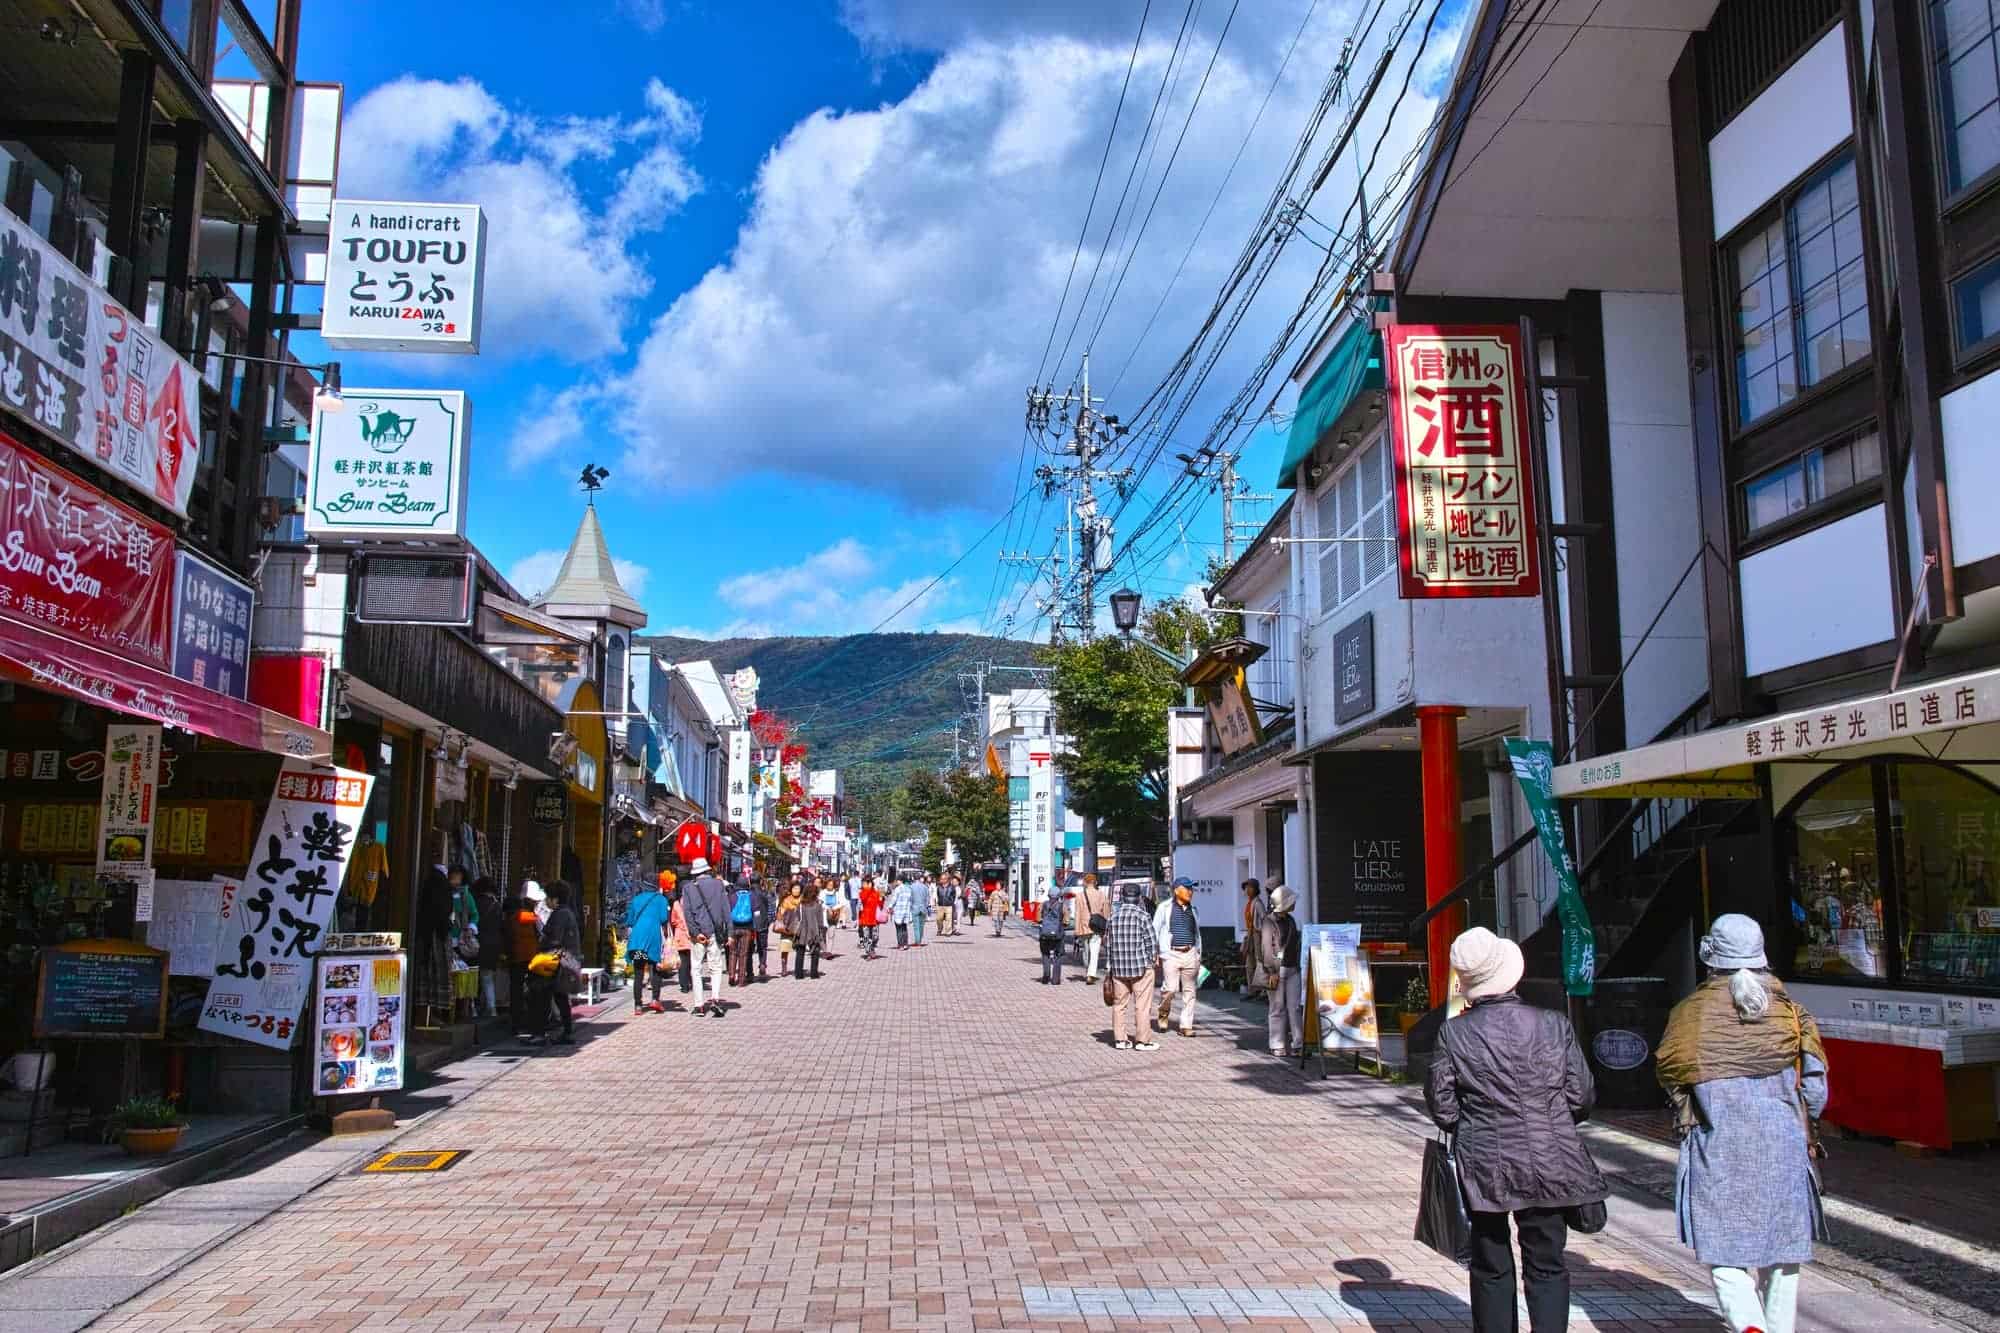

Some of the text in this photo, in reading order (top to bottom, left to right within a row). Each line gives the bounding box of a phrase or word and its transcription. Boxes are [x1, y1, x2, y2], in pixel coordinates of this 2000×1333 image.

[351, 213, 461, 232] A handicraft
[342, 237, 467, 265] TOUFU
[0, 229, 90, 369] 料理
[350, 271, 455, 304] とうふ
[349, 305, 445, 320] KARUIZAWA
[421, 322, 456, 334] つる吉
[1410, 347, 1504, 381] 信州の
[96, 303, 128, 464] つる吉
[1414, 383, 1504, 459] 酒
[335, 459, 433, 476] 軽井沢紅茶館
[1447, 471, 1513, 501] ワイン
[327, 491, 436, 514] Sun Beam
[1421, 472, 1438, 574] 軽井沢芳光 旧道店
[1449, 506, 1517, 538] 地ビール
[0, 531, 102, 598] Sun Beam
[1452, 546, 1519, 577] 地酒
[1745, 686, 1976, 757] 軽井沢芳光 旧道店
[1353, 840, 1401, 858] L'ATE
[270, 812, 353, 958] 軽井沢
[1353, 861, 1393, 880] LIER
[215, 834, 297, 981] とうふ
[244, 1014, 295, 1040] つる吉
